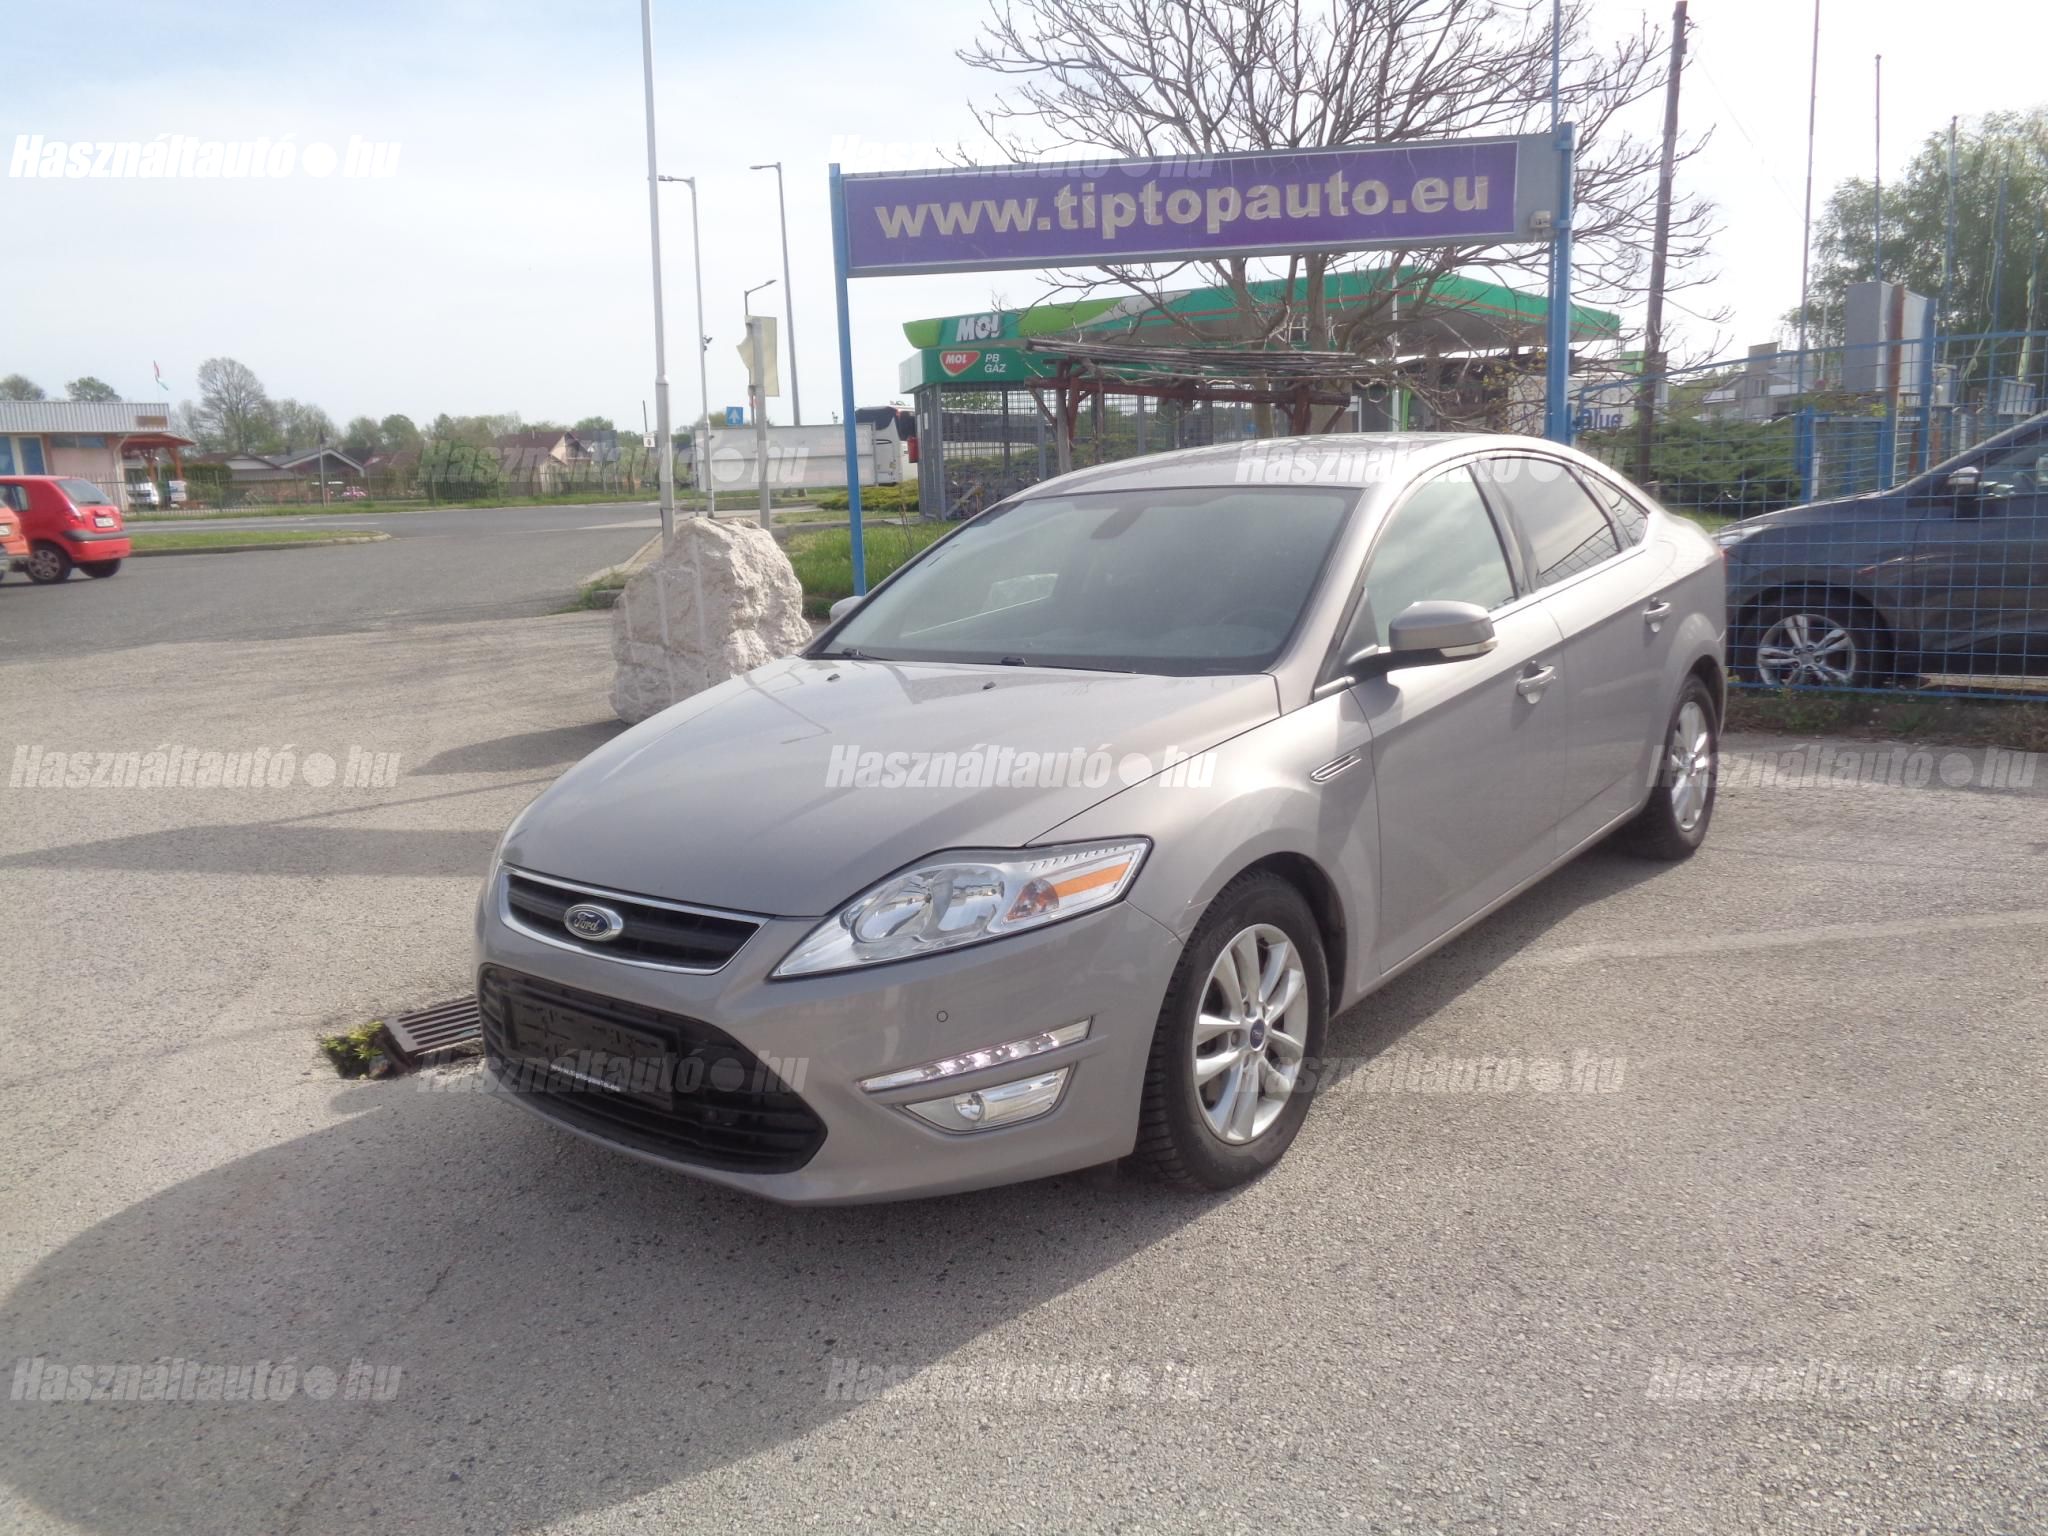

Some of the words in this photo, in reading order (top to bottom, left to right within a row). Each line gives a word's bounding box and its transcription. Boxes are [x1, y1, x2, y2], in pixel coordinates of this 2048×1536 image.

[874, 168, 1490, 239] www.tiptopauto.eu
[985, 353, 1000, 363] PB
[573, 911, 601, 933] Ford
